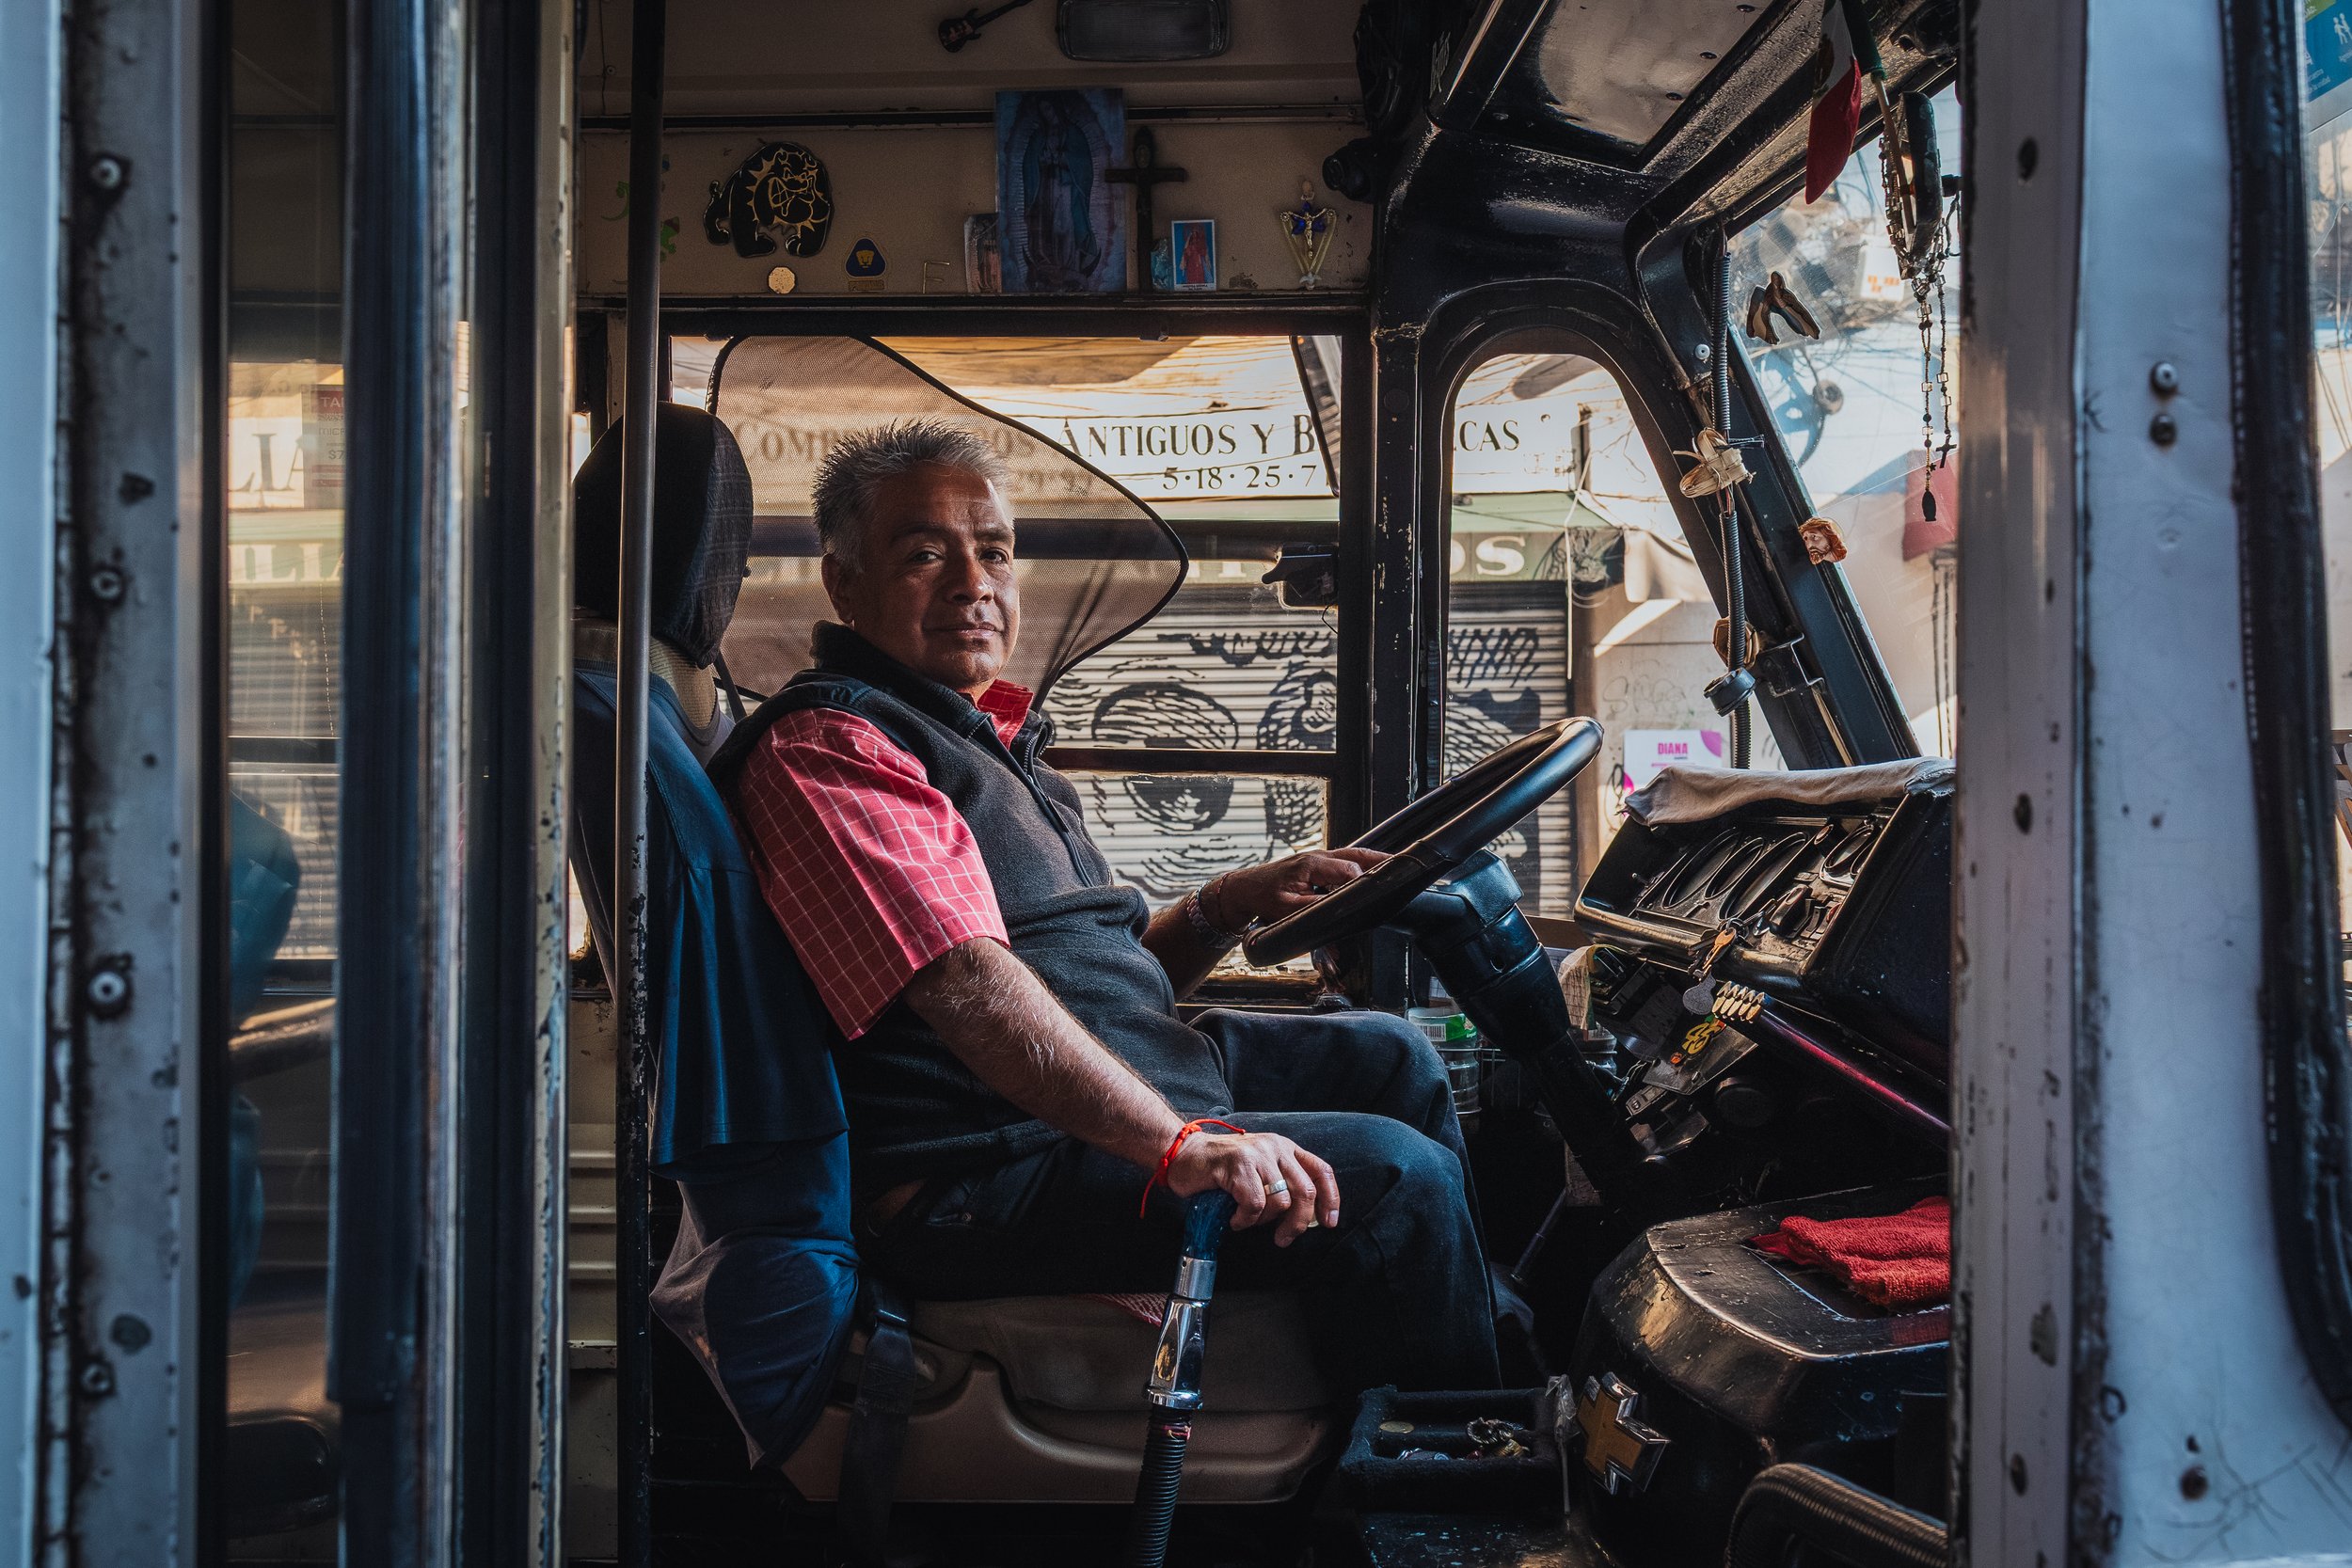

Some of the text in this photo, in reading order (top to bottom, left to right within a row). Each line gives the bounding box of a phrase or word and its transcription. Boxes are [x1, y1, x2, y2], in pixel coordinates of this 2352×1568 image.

[1059, 418, 1238, 457] ANTIGUOS
[1250, 422, 1275, 455] Y
[1454, 420, 1521, 452] CAS
[1657, 741, 1689, 755] DIANA
